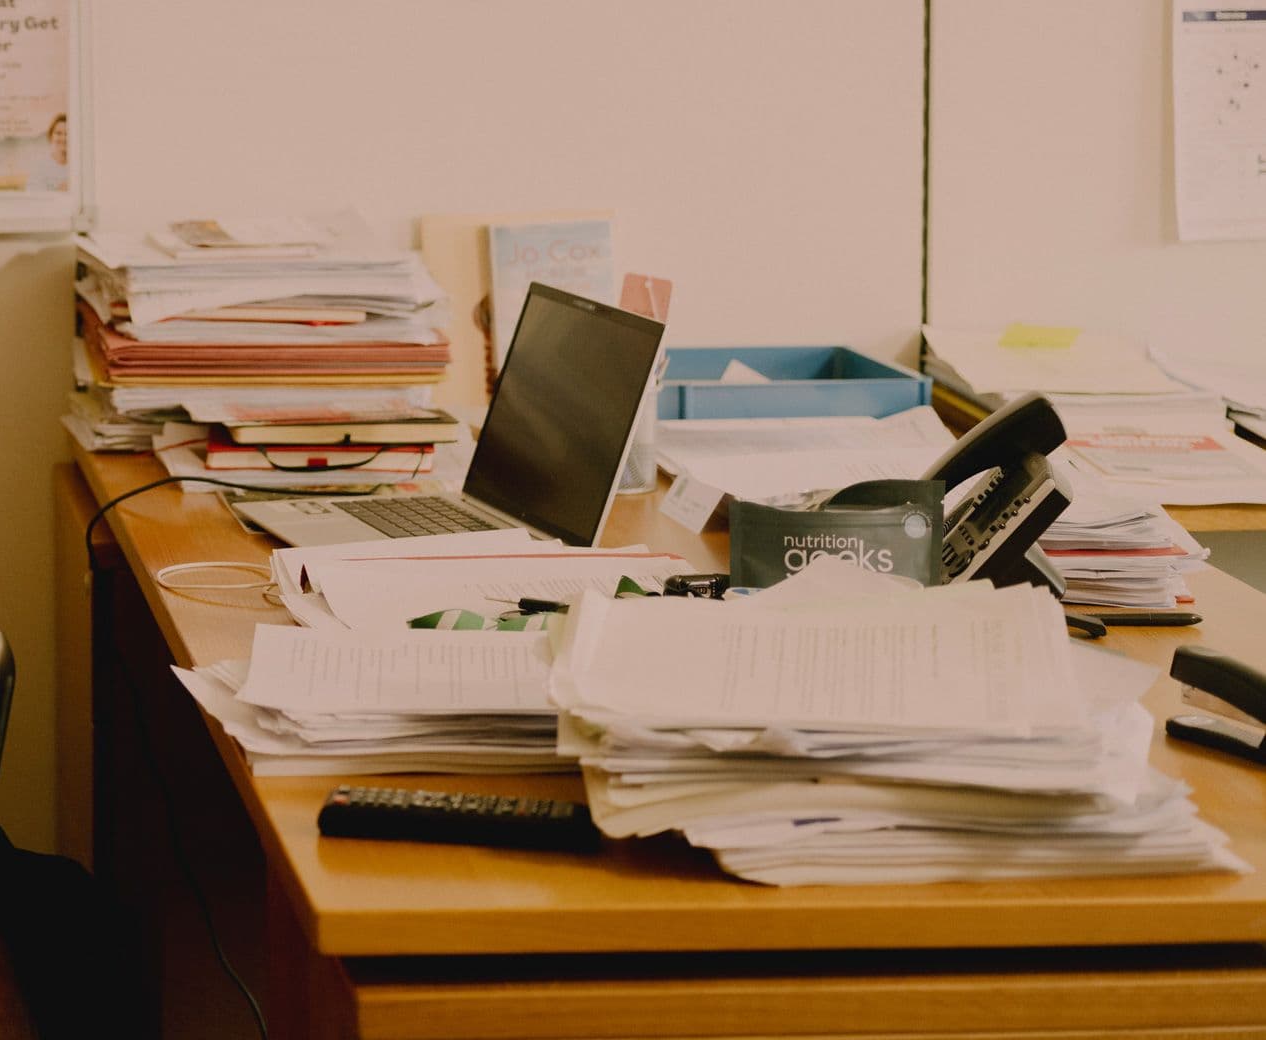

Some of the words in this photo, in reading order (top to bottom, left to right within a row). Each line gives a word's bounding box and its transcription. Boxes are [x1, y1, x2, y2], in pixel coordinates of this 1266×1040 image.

[24, 16, 59, 30] Get
[509, 240, 539, 266] Jo
[547, 239, 603, 262] Cox
[784, 534, 858, 548] nutrition
